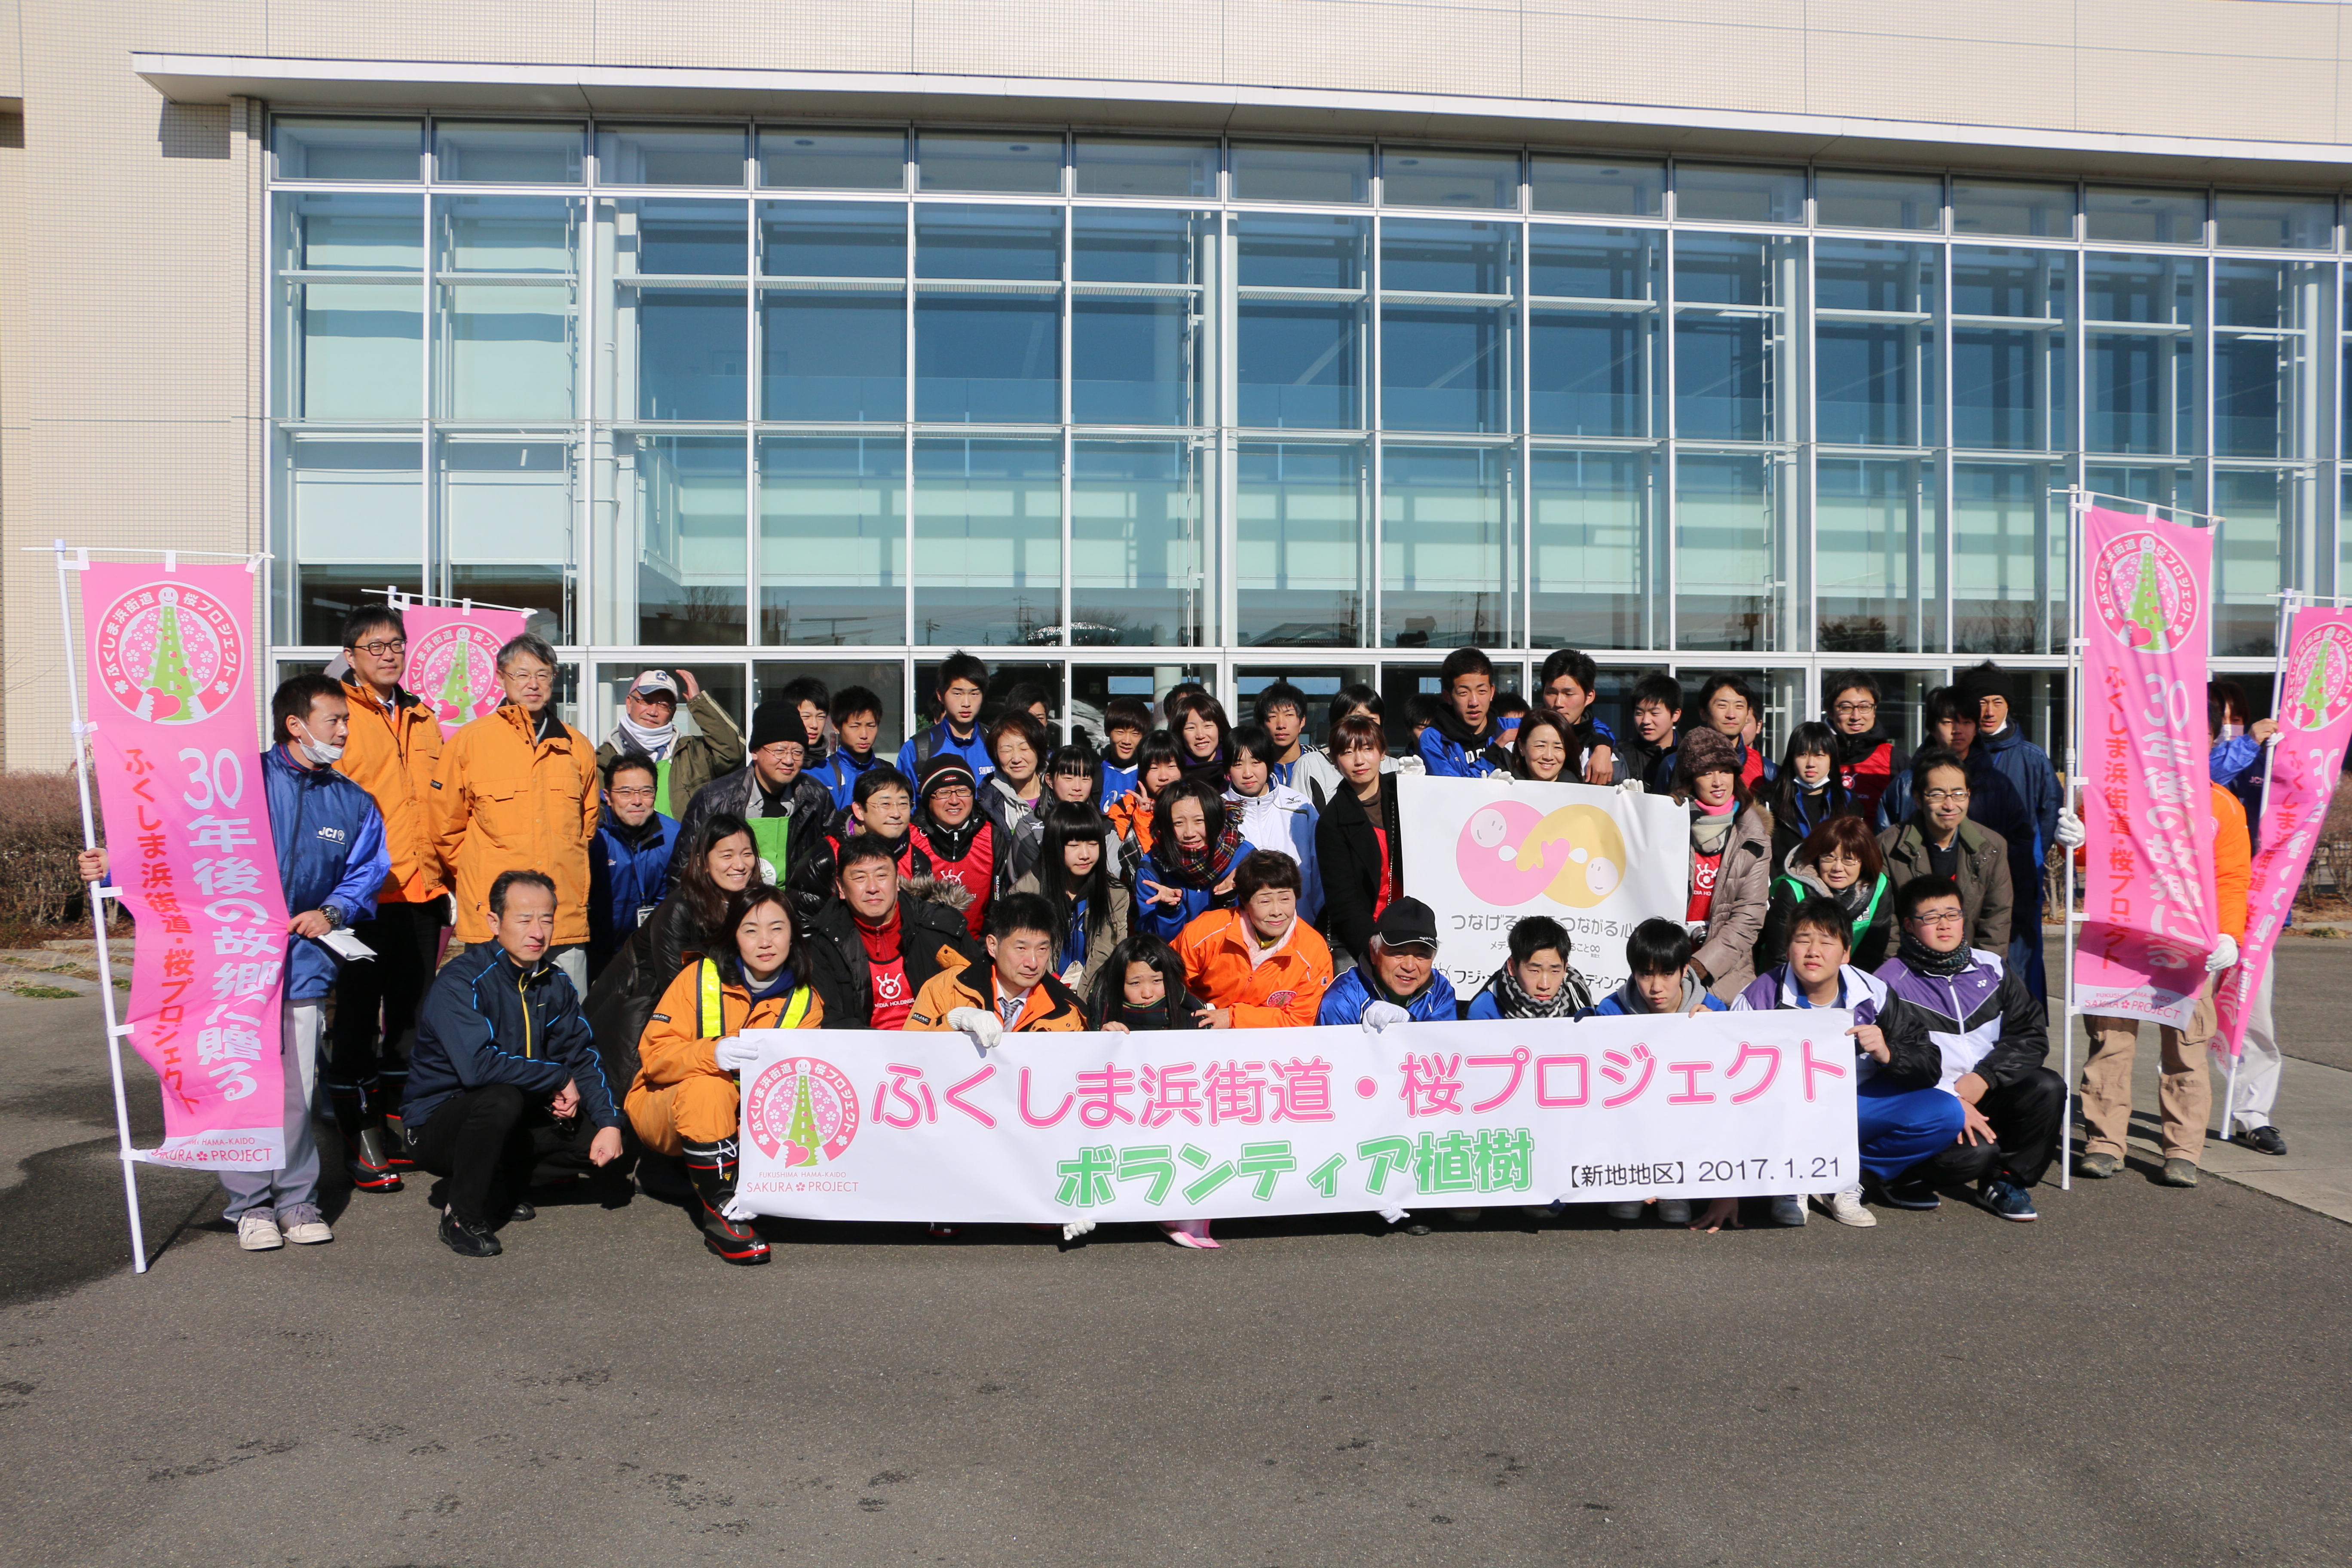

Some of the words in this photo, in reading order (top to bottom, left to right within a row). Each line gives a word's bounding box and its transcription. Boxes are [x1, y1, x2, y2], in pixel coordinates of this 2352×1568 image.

[102, 591, 155, 677] ふくしま浜街道
[183, 592, 237, 678] 桜プロジェクト
[410, 629, 453, 691] ふくしま浜街道
[318, 826, 337, 839] JCI
[178, 747, 282, 1102] 30年後の故郷に贈る
[889, 998, 915, 1007] HOLDINGS
[2131, 1000, 2181, 1020] PROJECT
[751, 1062, 793, 1132] ふくしま浜街道
[814, 1063, 856, 1133] 桜プロジェクト
[870, 1039, 1847, 1130] ふくしま浜街道・桜プロジェクト
[211, 1148, 272, 1162] PROJECT
[1055, 1128, 1535, 1208] ボランティア植樹
[746, 1182, 793, 1193] SAKURA
[808, 1181, 859, 1193] PROJECT
